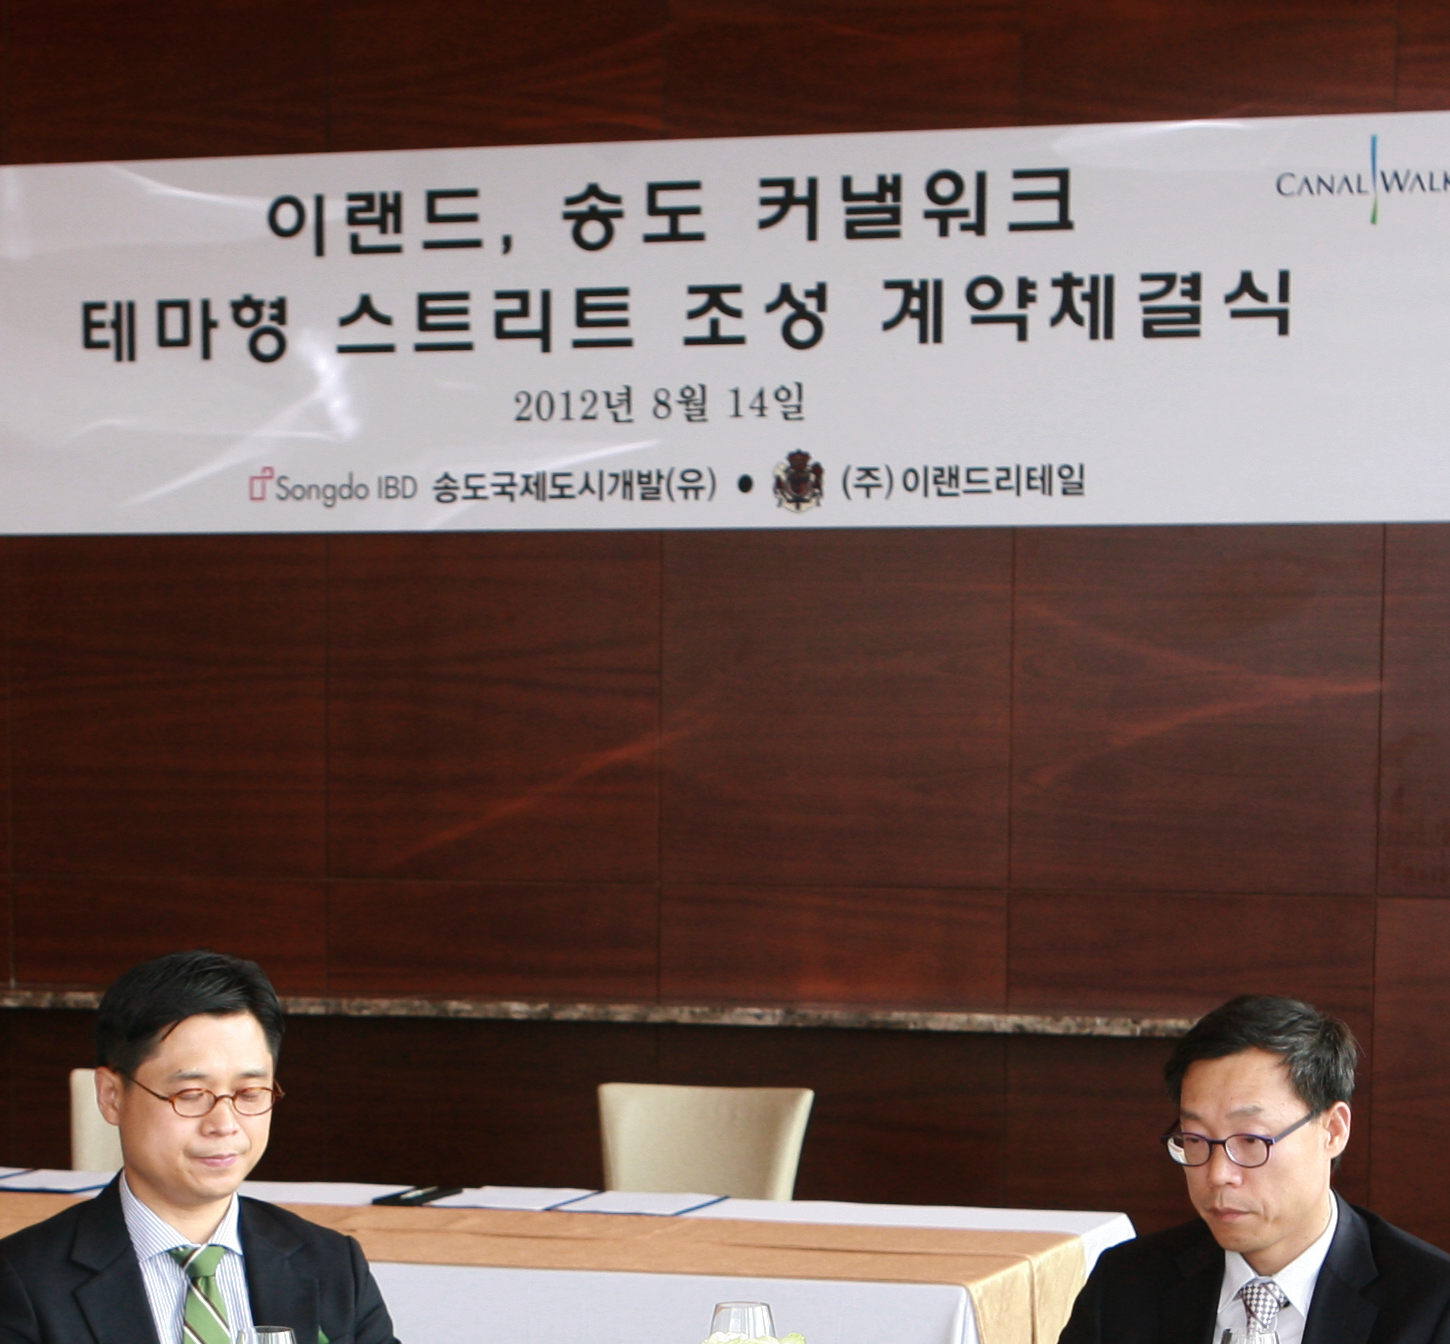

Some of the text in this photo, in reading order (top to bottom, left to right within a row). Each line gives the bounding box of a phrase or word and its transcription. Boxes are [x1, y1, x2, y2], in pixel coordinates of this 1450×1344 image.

[1275, 172, 1369, 197] CANAL
[266, 167, 1075, 258] 이랜드, 송도 커낼워크
[81, 269, 1291, 365] 테마형 스트리트 조성 계약체결식
[515, 381, 805, 424] 2012년 8월 14일
[276, 475, 368, 508] Songdo
[378, 475, 417, 500] IBD
